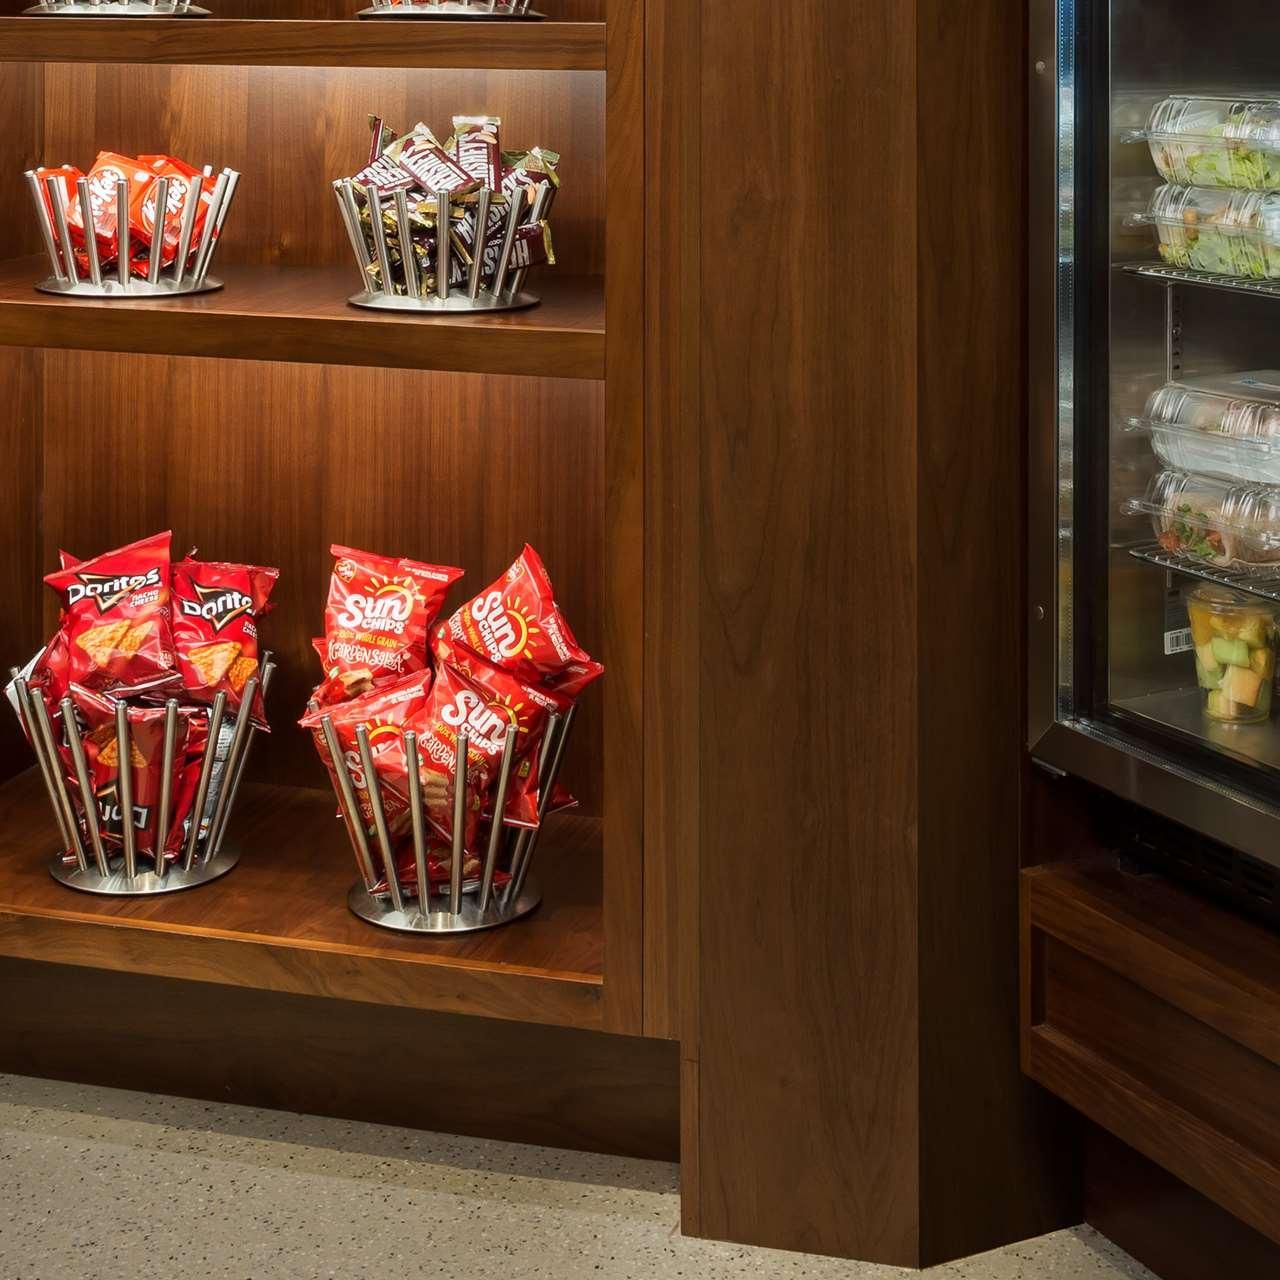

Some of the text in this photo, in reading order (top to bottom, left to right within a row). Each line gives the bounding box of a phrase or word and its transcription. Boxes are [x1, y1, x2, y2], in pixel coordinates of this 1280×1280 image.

[67, 568, 160, 606] Doritos
[182, 592, 256, 620] Dorito
[338, 592, 414, 629] Sun
[471, 591, 522, 658] Sun
[361, 618, 406, 635] CHIPS
[441, 689, 511, 746] Sun
